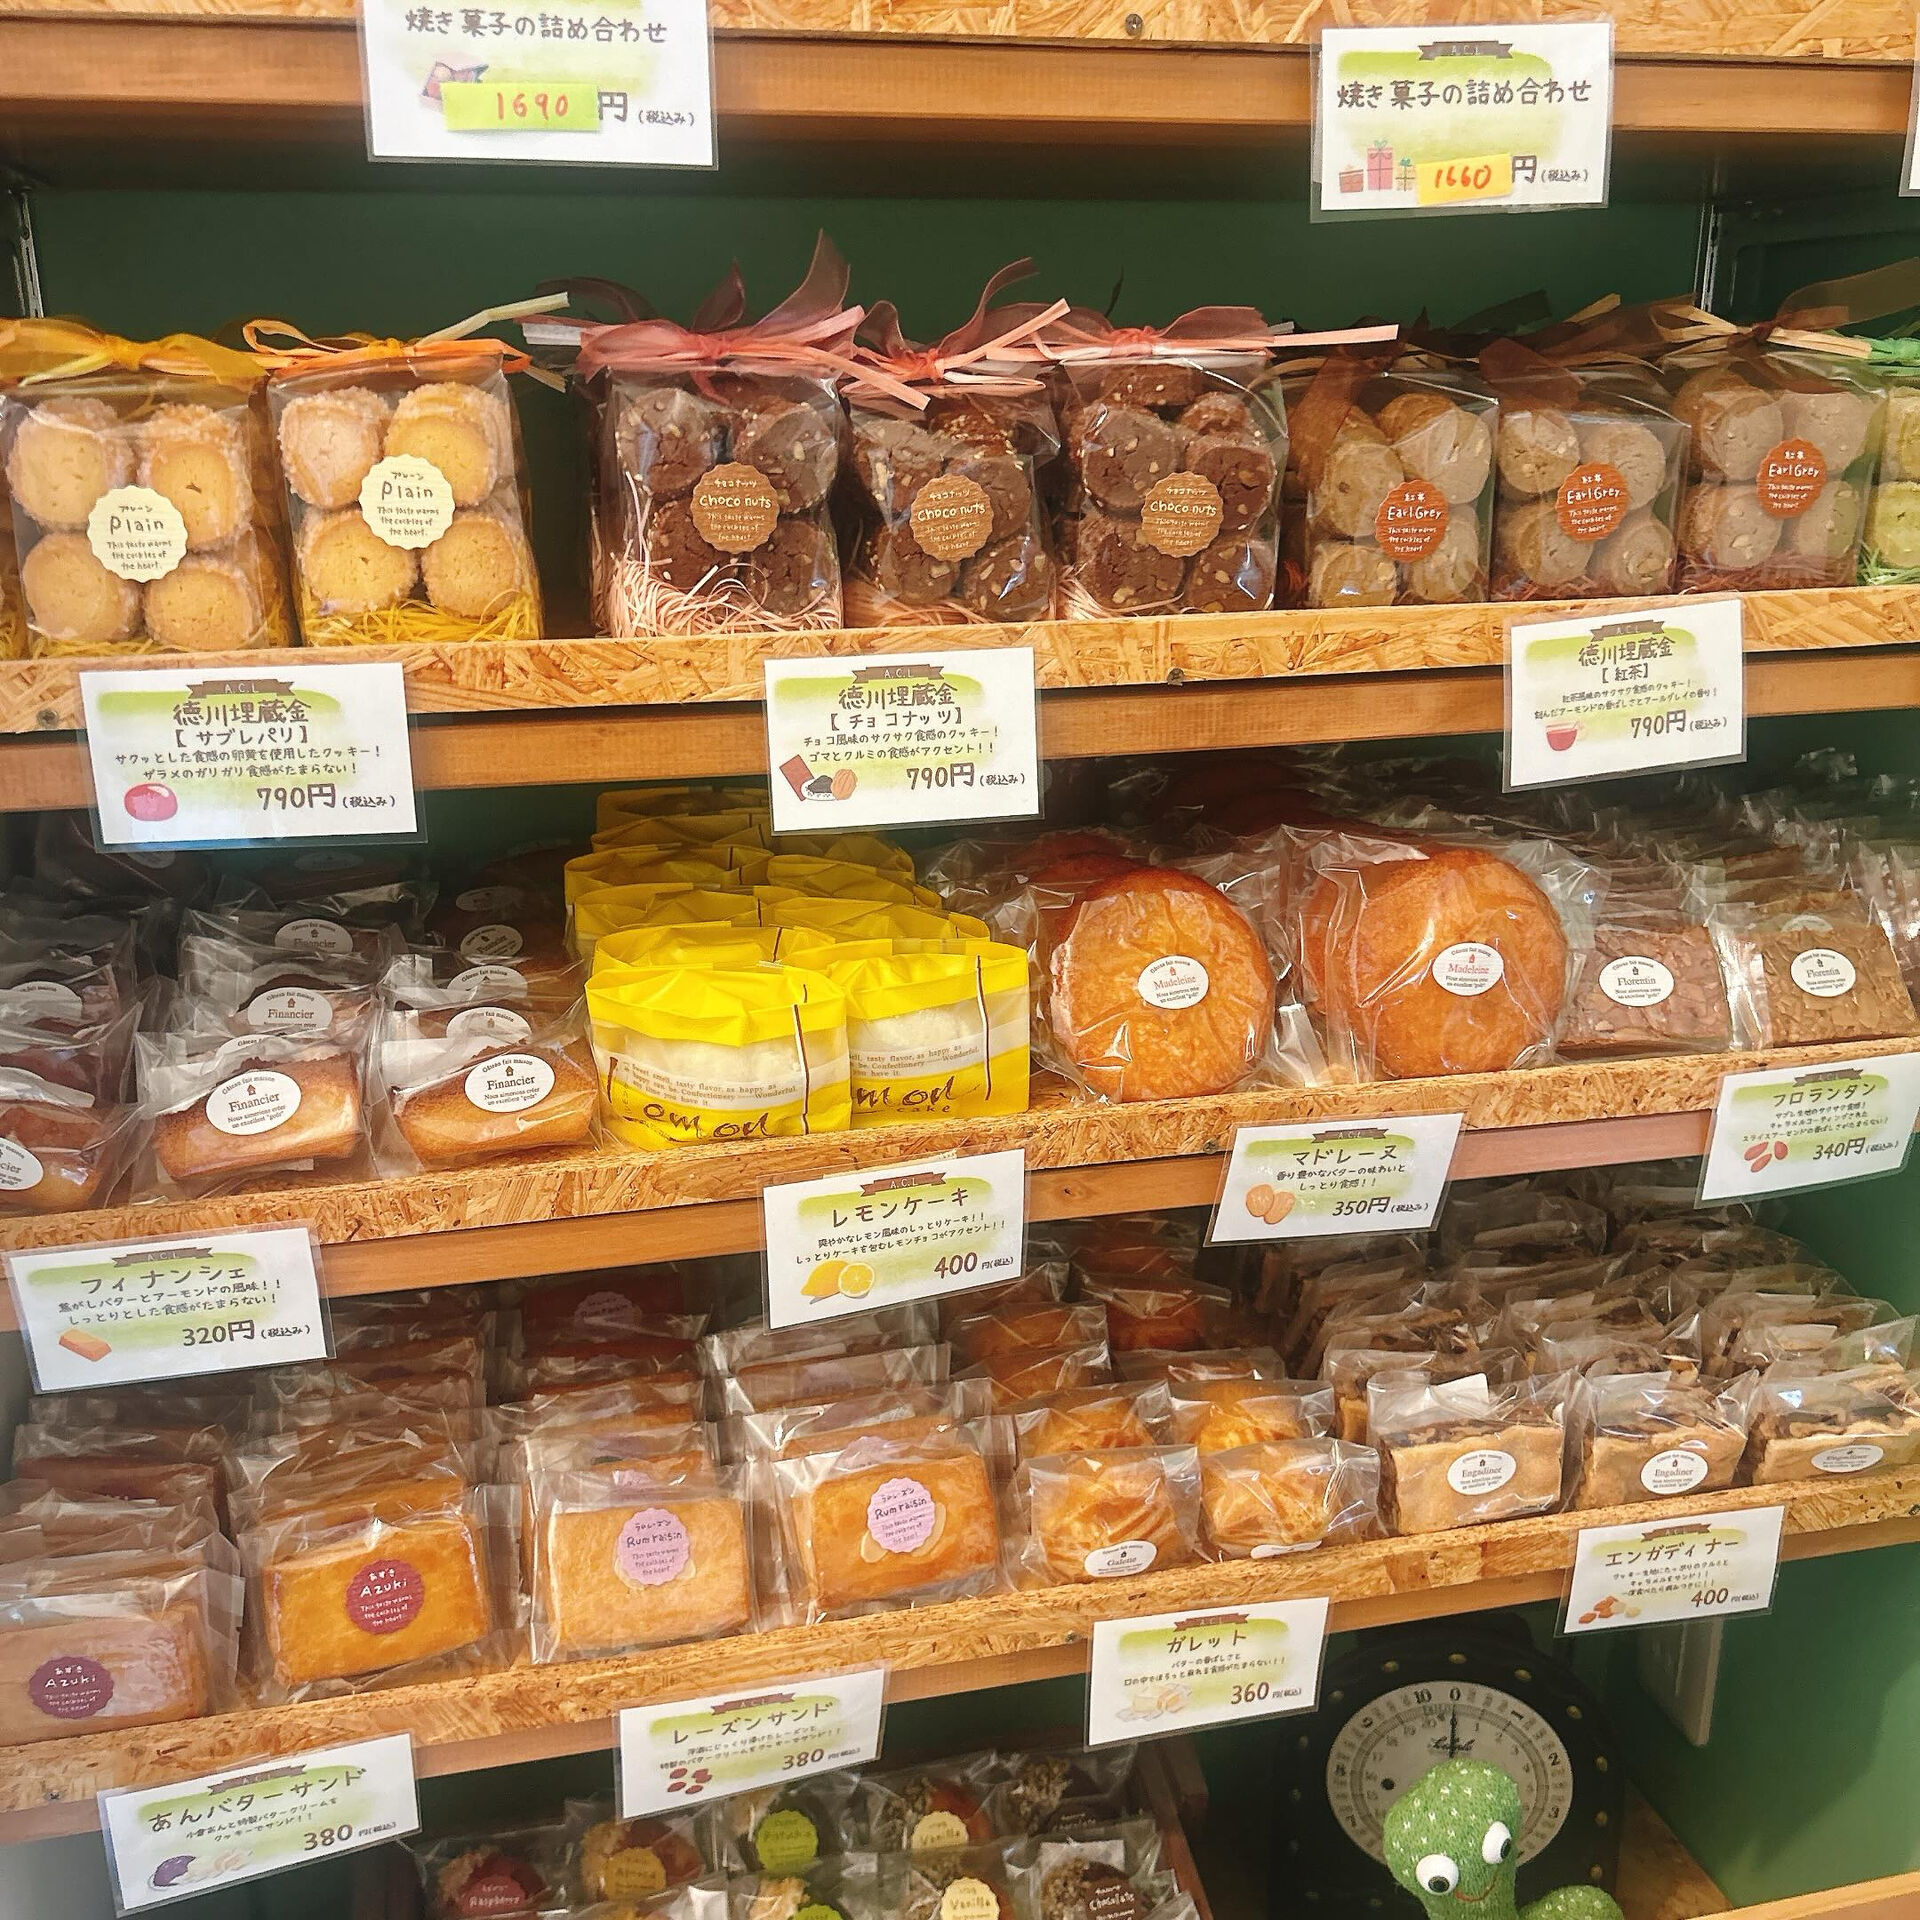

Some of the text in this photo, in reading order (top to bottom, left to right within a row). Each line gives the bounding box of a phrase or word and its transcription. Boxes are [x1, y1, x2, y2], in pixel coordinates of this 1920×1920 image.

[406, 9, 667, 43] 焼き菓子の詰め合わせ
[497, 92, 568, 120] 1690
[598, 91, 627, 121] 円
[1337, 78, 1591, 110] 焼き菓子の詰め合わせ
[1435, 165, 1491, 189] 1660
[1512, 155, 1536, 183] 円
[382, 481, 433, 500] Plain
[745, 495, 772, 508] nuts
[960, 502, 986, 515] nuts
[1192, 505, 1217, 517] nuts
[110, 515, 164, 535] Plain
[1579, 636, 1676, 666] 徳川埋蔵金
[839, 683, 957, 709] 徳川埋蔵金
[173, 699, 311, 726] 徳川埋蔵金
[1631, 710, 1686, 739] 790円
[906, 762, 974, 789] 790円
[257, 784, 335, 810] 790円
[1153, 976, 1197, 990] Madeleine
[267, 1009, 314, 1020] Financier
[928, 1047, 951, 1057] happy
[487, 1075, 536, 1091] Financier
[677, 1081, 694, 1090] tasty
[739, 1086, 763, 1094] happy
[228, 1092, 280, 1112] Financier
[1773, 1083, 1876, 1108] フロランタン
[1293, 1144, 1397, 1166] マドレーヌ
[1813, 1137, 1866, 1161] 340円
[833, 1187, 969, 1228] レモンケーキ
[1332, 1197, 1391, 1217] 350円
[933, 1252, 978, 1280] 400
[80, 1265, 246, 1295] フィナンシェ
[183, 1320, 255, 1347] 320円
[875, 1498, 927, 1520] Rum raisin
[627, 1536, 650, 1548] Rum
[1605, 1538, 1740, 1568] エンガディナー
[360, 1578, 407, 1598] Azuki
[1690, 1587, 1729, 1608] 400
[1167, 1629, 1247, 1654] ガレット
[45, 1674, 96, 1688] Azuki
[1230, 1681, 1270, 1705] 360
[1414, 1688, 1433, 1704] 10
[1449, 1687, 1461, 1701] 0
[673, 1701, 834, 1744] レーズンサンド
[781, 1748, 825, 1771] 380
[150, 1767, 367, 1833] あんバターサンド
[304, 1823, 353, 1851] 380
